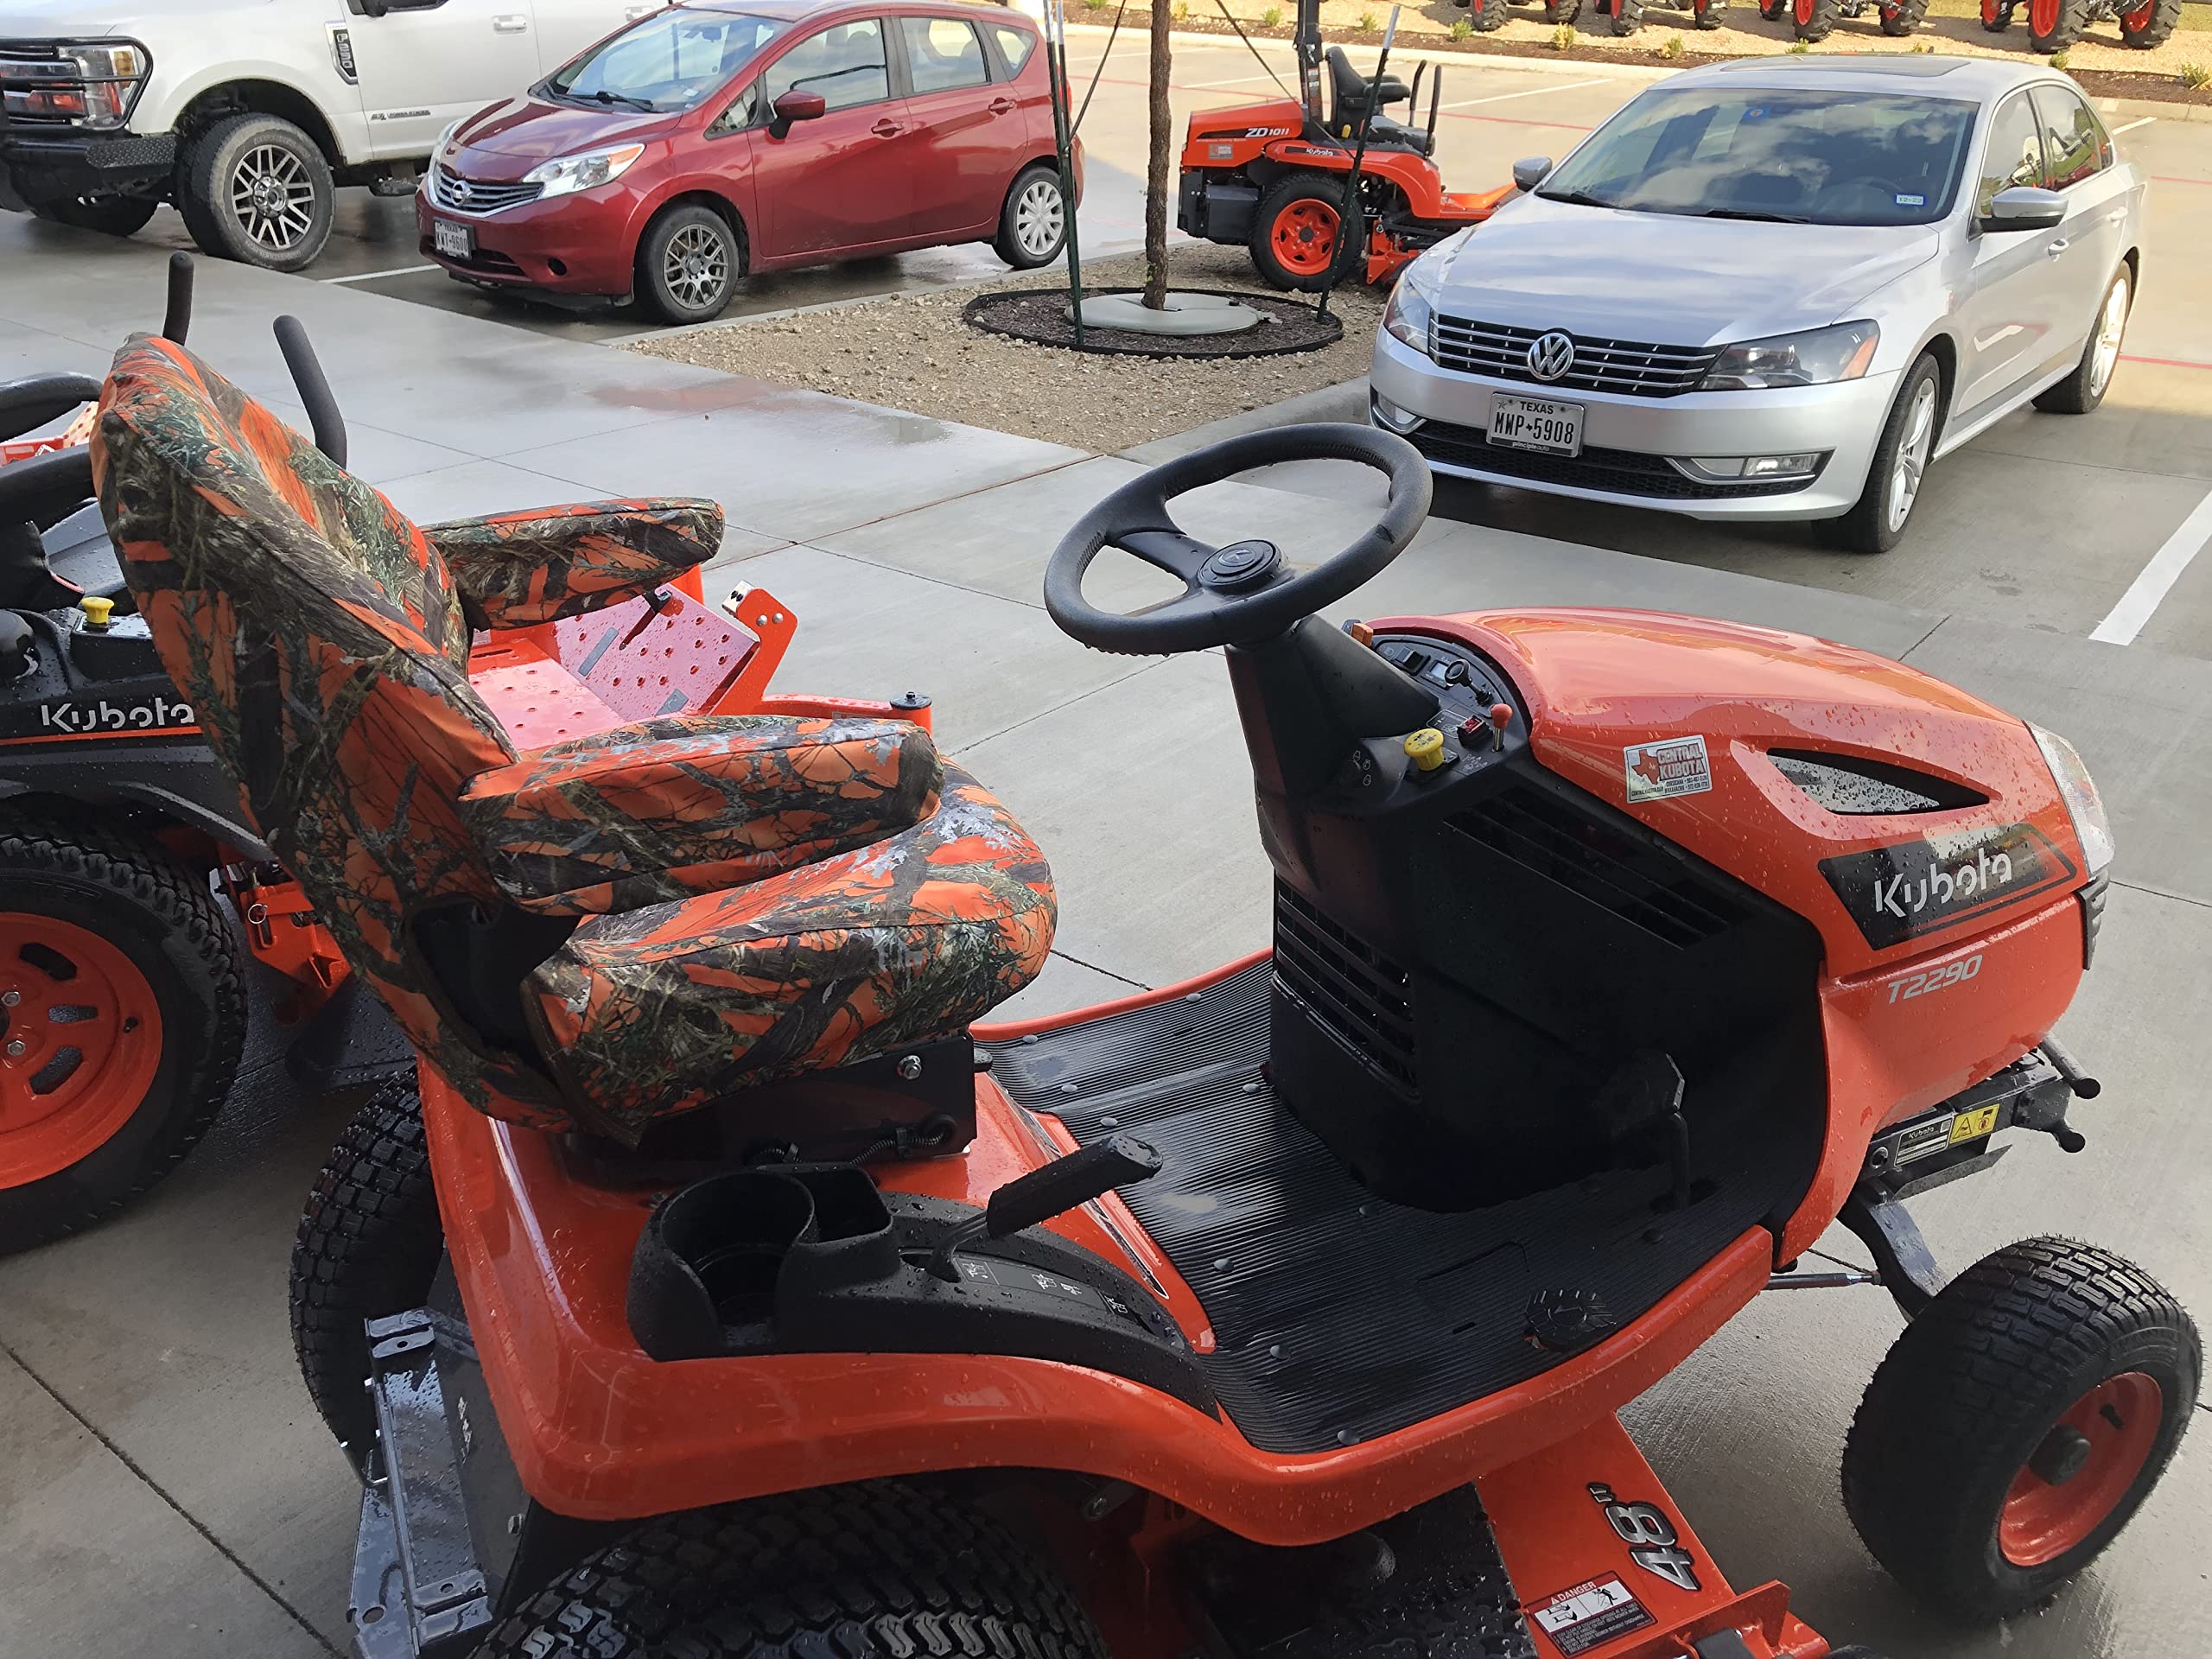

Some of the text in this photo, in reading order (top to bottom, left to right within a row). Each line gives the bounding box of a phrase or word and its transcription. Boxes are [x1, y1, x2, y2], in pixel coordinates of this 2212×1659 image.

[1306, 147, 1334, 156] Kubota
[1520, 401, 1554, 414] TEXAS
[41, 697, 194, 733] Kubota
[1657, 743, 1702, 764] CENTRAL
[1659, 759, 1705, 780] KUBOTA
[1874, 847, 2012, 918] Kubota
[1887, 954, 1982, 1004] T2290
[1909, 1126, 1935, 1138] Kubota
[1558, 1581, 1597, 1601] DANGER
